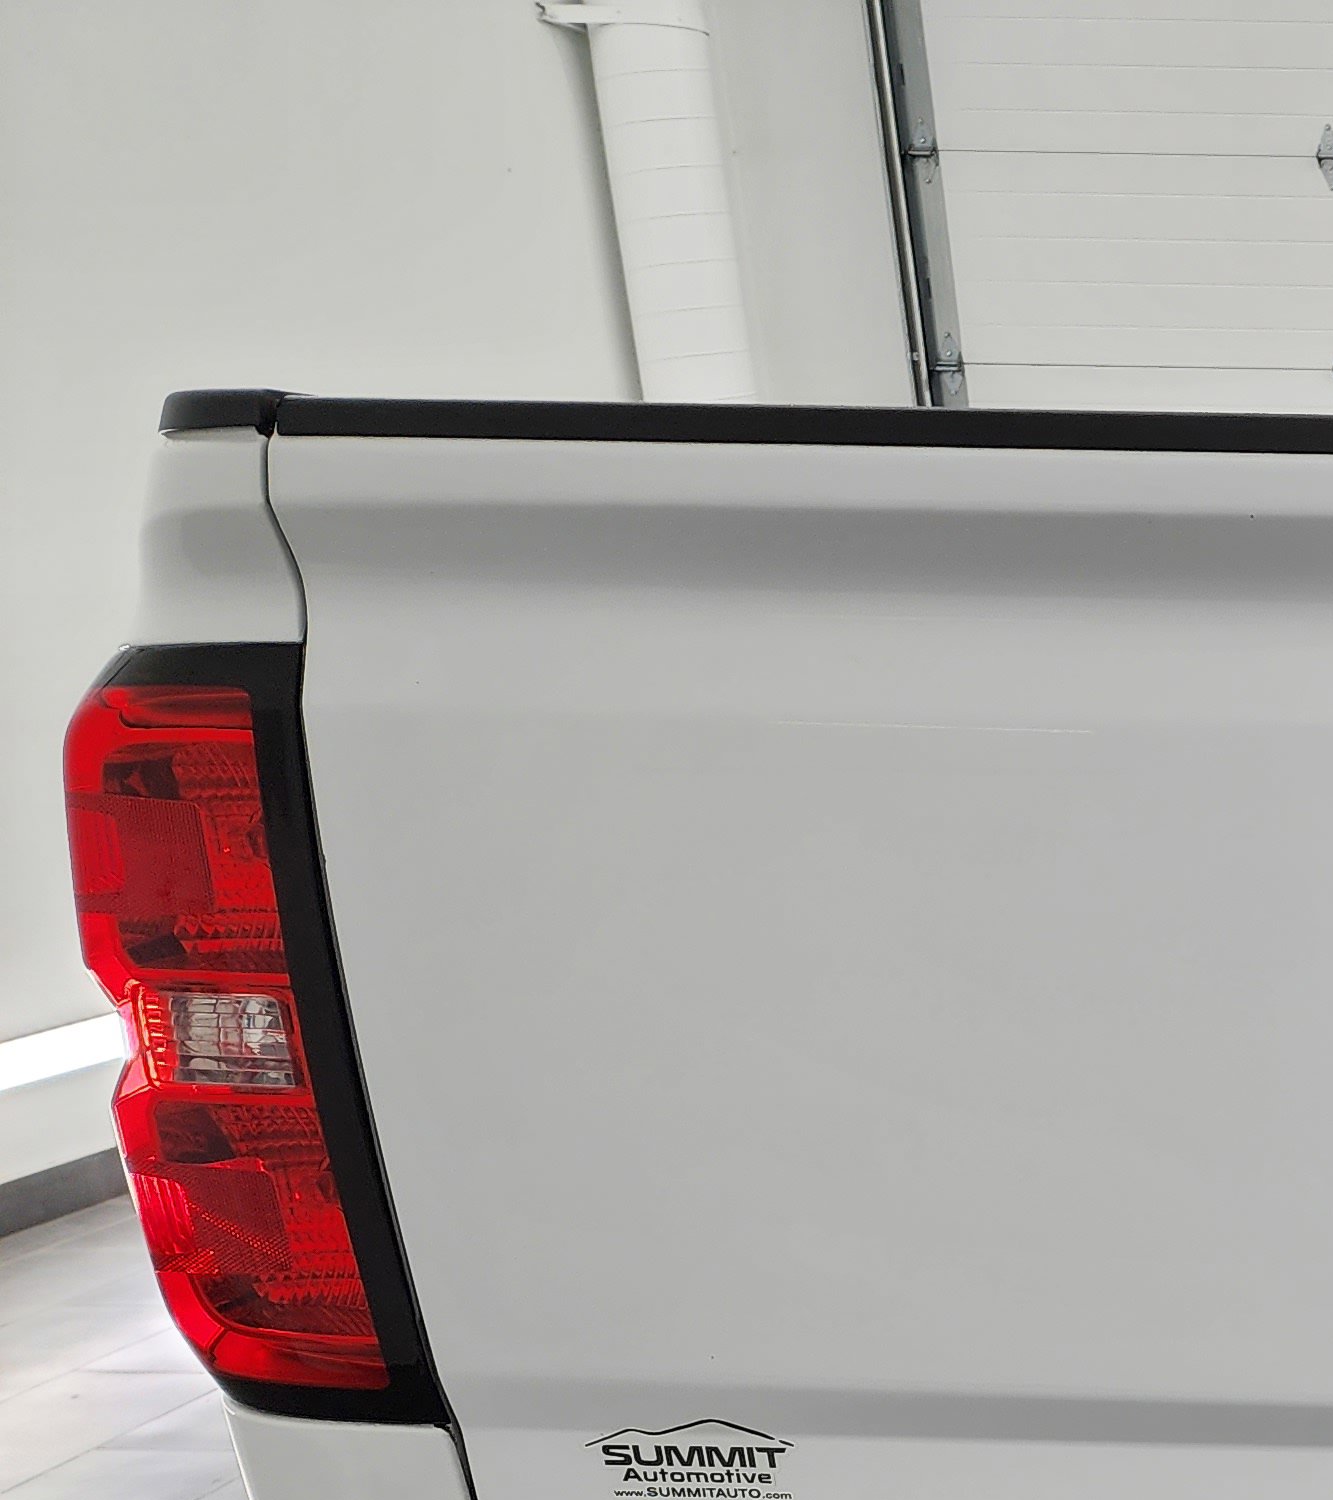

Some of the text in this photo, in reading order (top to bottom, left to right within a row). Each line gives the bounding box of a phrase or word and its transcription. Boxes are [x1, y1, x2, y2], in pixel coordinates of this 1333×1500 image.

[602, 1445, 787, 1468] SUMMIT
[623, 1468, 772, 1484] Automotive
[614, 1487, 792, 1499] www.SUMMITAUTO.com
